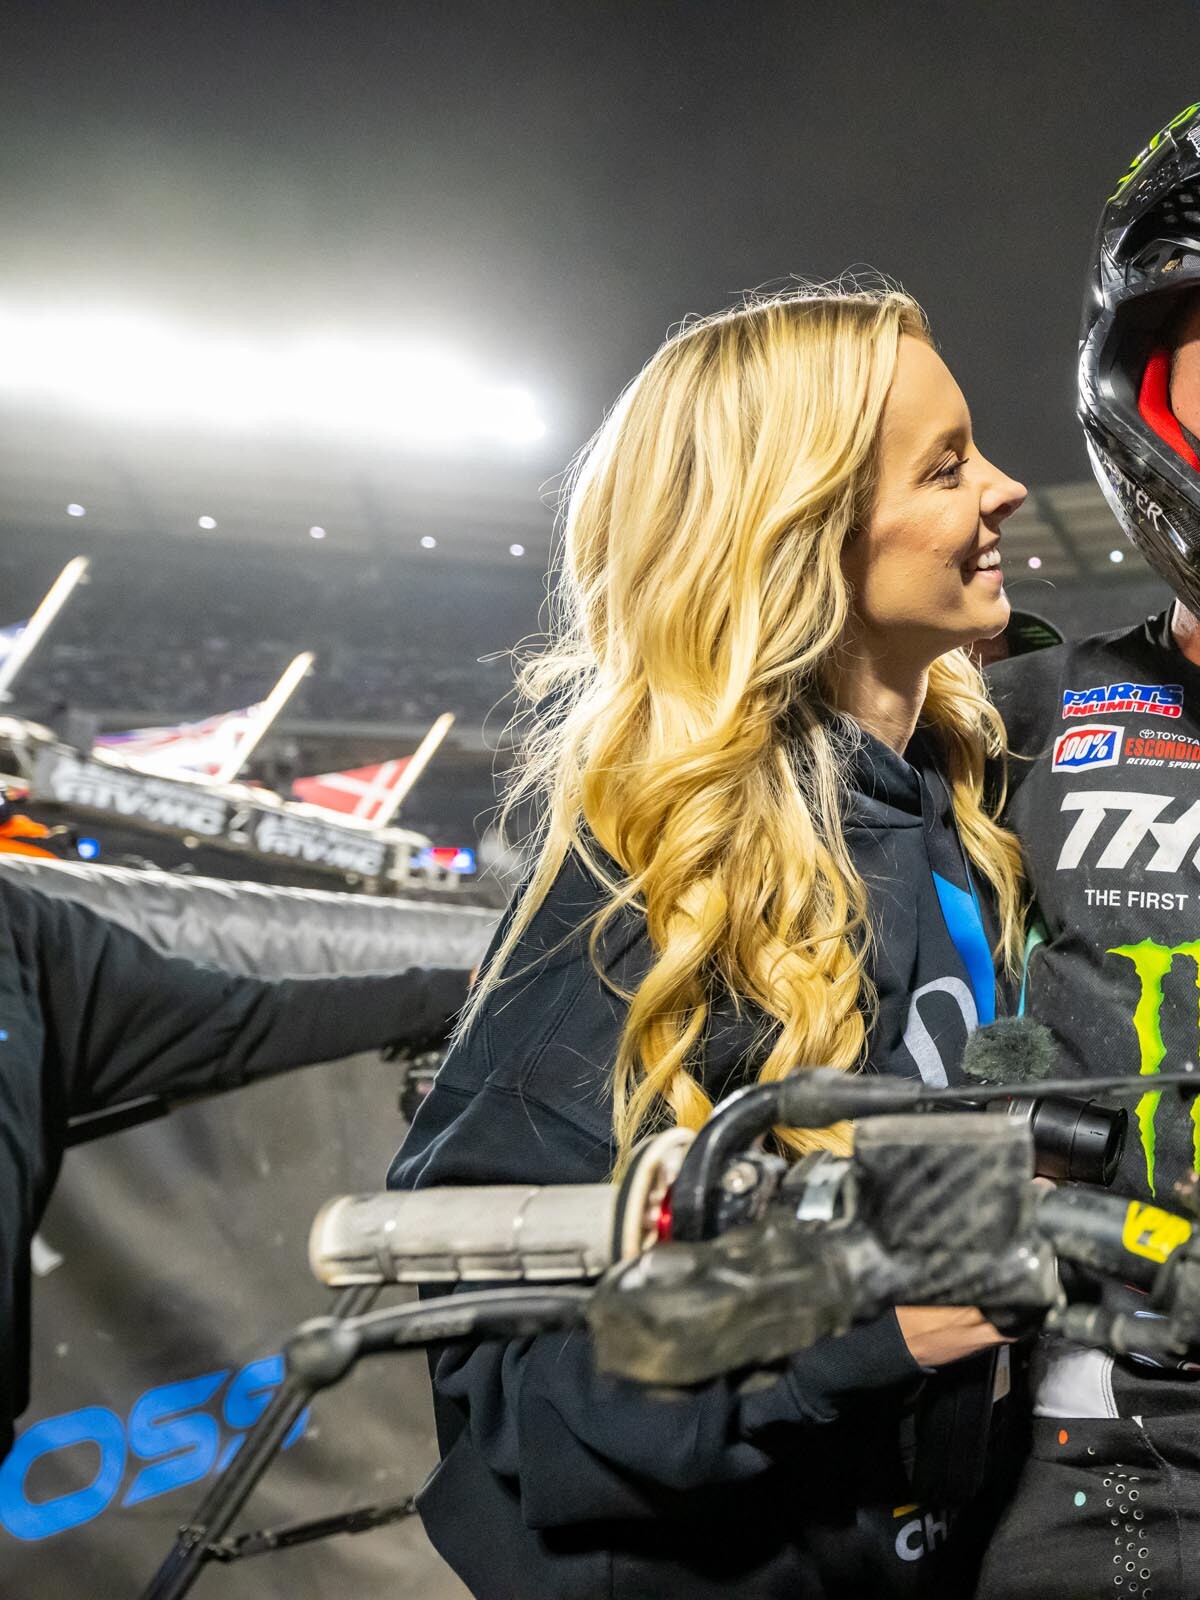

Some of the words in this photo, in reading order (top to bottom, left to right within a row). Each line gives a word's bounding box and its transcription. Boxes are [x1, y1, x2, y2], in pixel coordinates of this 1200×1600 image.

[1064, 682, 1184, 705] PARTS
[1063, 700, 1182, 719] UNLIMITED
[1058, 732, 1110, 762] 100%
[1156, 731, 1200, 746] TOYOTA
[1126, 757, 1165, 767] ACTION
[1085, 889, 1121, 906] THE
[1127, 891, 1189, 911] FIRST
